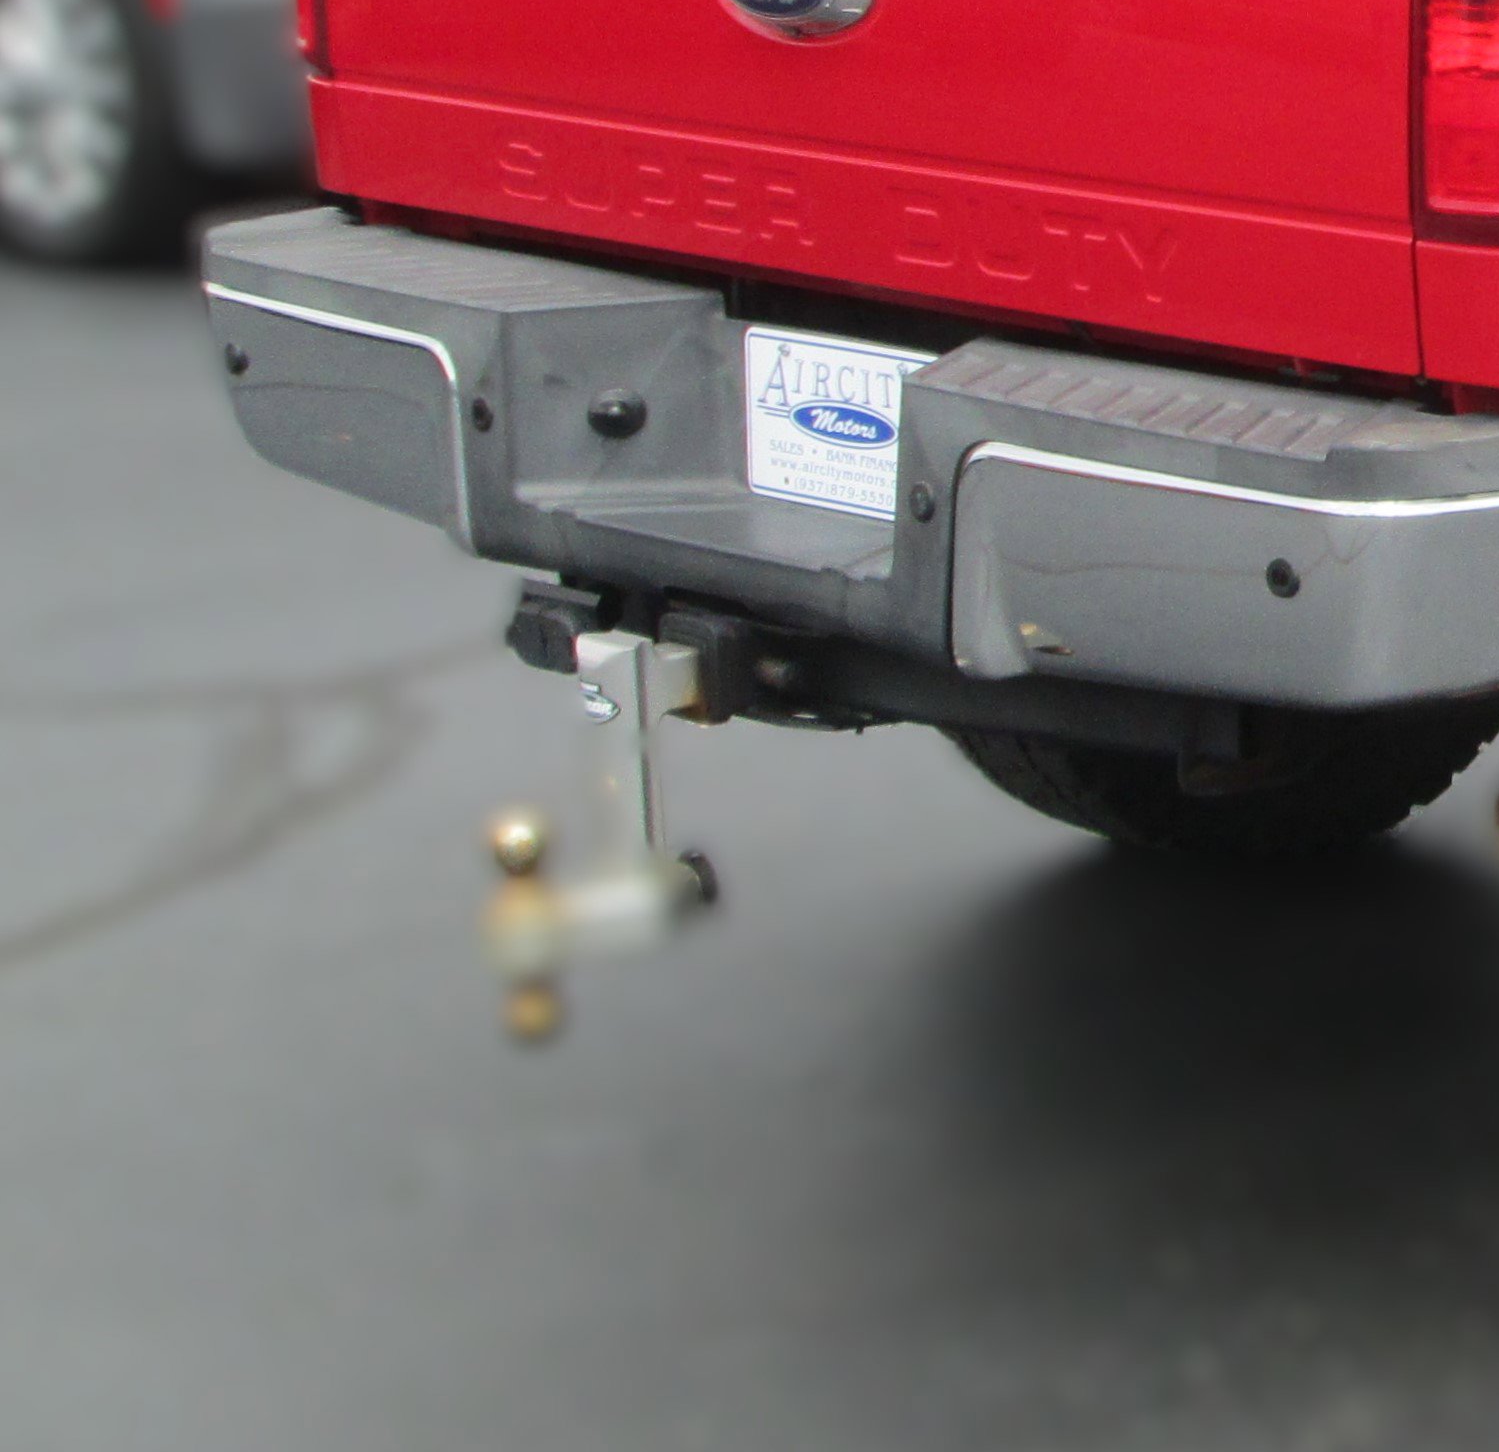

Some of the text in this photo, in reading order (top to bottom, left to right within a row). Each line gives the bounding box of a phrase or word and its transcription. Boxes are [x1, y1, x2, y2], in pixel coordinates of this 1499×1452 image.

[499, 142, 1180, 303] SUPER DUTY
[757, 354, 899, 408] AIRCIT
[810, 408, 878, 439] Motors
[770, 439, 804, 456] SALES
